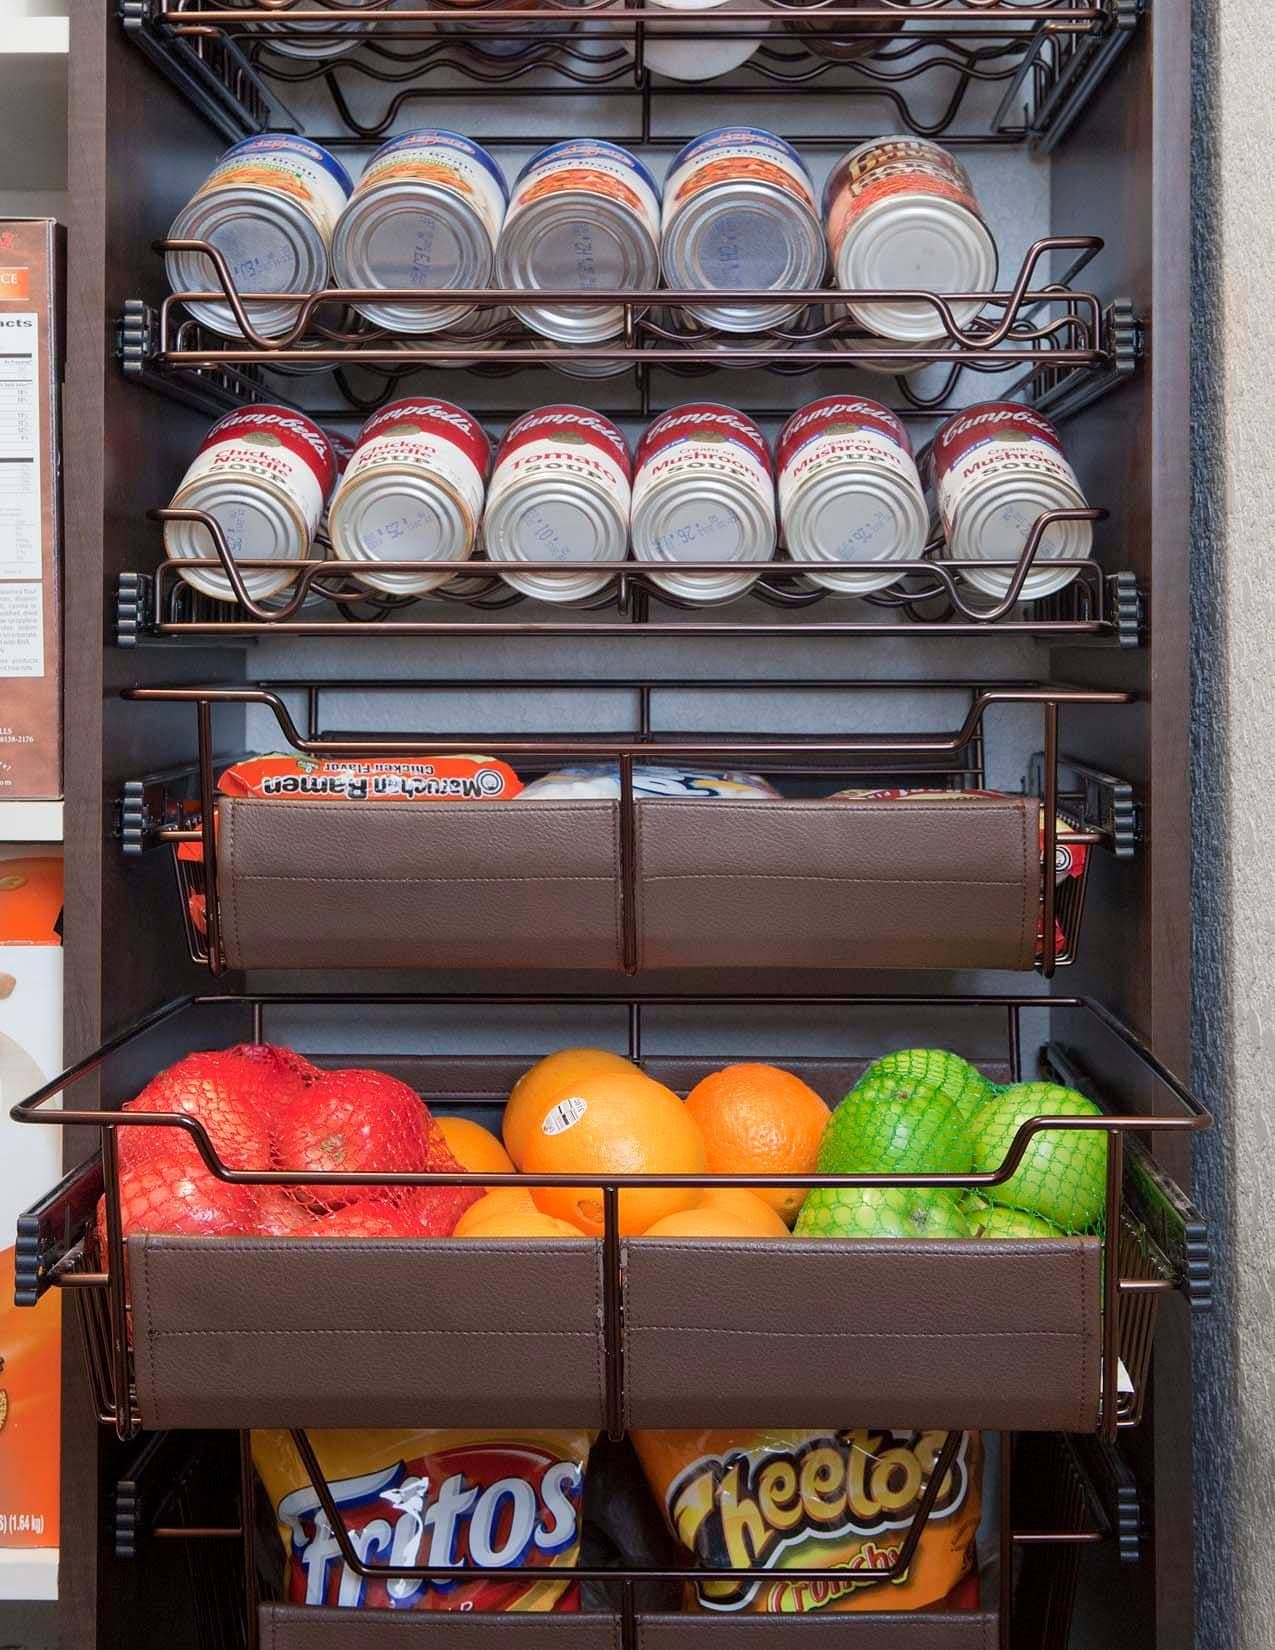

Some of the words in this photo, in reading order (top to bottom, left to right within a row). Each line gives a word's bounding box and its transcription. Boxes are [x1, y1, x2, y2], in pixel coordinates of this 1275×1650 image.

[359, 447, 433, 465] Noodle
[360, 441, 436, 459] Chicken
[793, 444, 901, 477] Mushroom
[214, 456, 289, 477] Noodle
[215, 449, 293, 473] Chicken
[512, 452, 617, 484] Tomato
[525, 462, 603, 480] SOUP
[652, 451, 760, 482] Mushroom
[667, 462, 746, 477] SOUP
[808, 453, 885, 473] SOUP
[963, 452, 1074, 479] Mushroom
[983, 462, 1058, 476] SOUP
[208, 463, 287, 484] SOUP
[324, 762, 370, 774] Flavor
[375, 763, 434, 775] Chicken
[263, 774, 368, 800] Ramen
[278, 1460, 585, 1608] Fritos
[771, 1545, 909, 1613] Crunch
